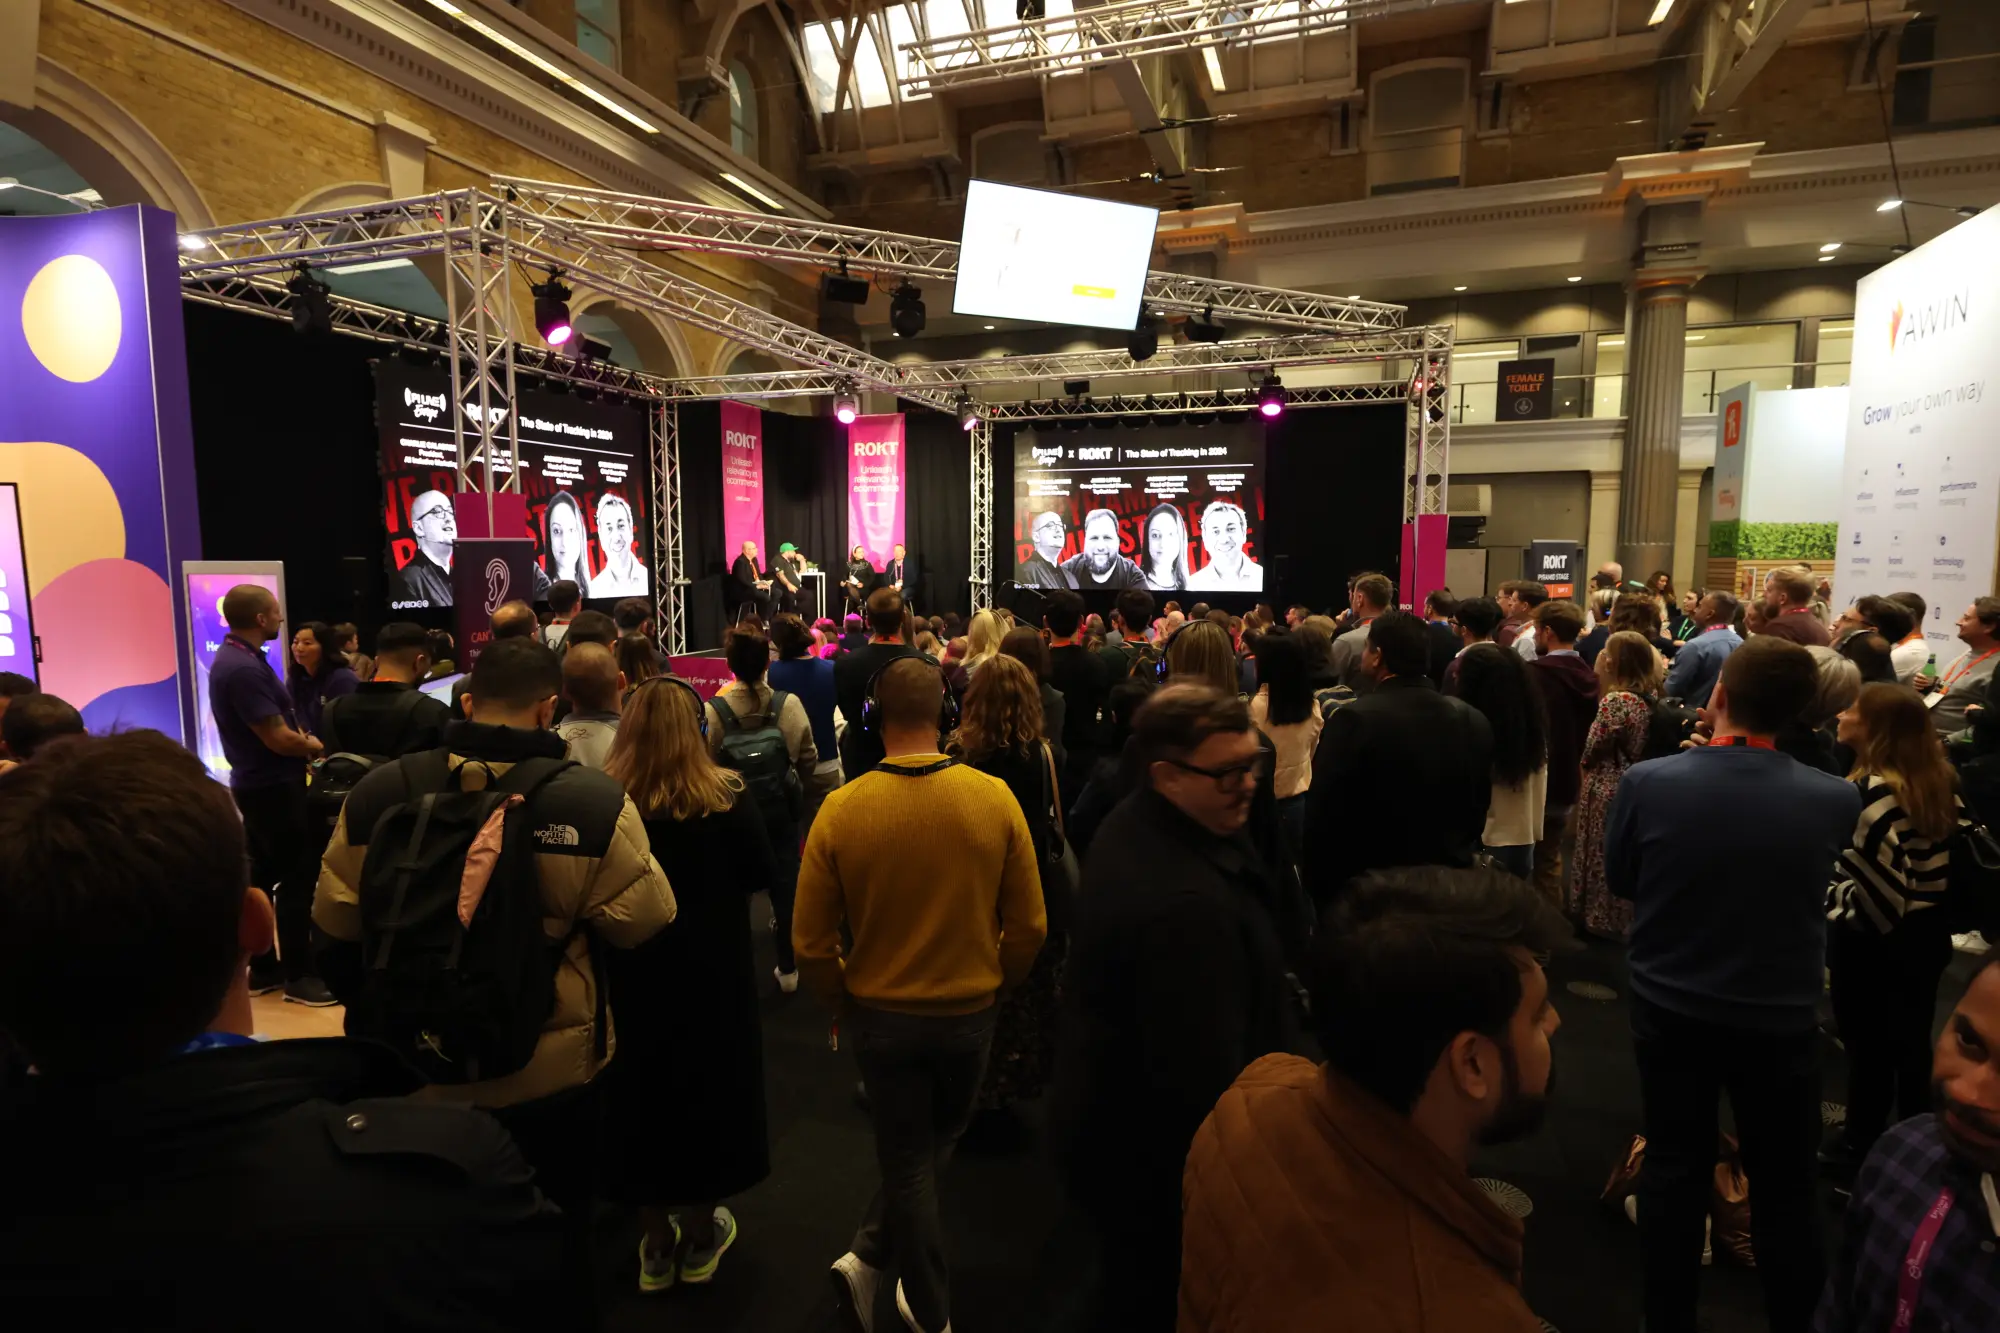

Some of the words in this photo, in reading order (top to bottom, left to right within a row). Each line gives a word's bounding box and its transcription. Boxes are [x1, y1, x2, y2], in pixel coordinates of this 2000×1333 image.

[1903, 286, 1969, 345] AWIN
[1506, 373, 1545, 384] FEMALE
[1508, 383, 1542, 393] TOILET
[1864, 405, 1892, 425] Grow
[1894, 398, 1921, 424] your
[1924, 389, 1952, 410] own
[1957, 379, 1985, 403] way
[519, 416, 534, 429] The
[726, 430, 757, 449] ROKT
[854, 441, 899, 457] ROKT
[1079, 447, 1113, 460] ROKT
[1125, 450, 1140, 458] The
[1160, 449, 1168, 457] of
[1168, 448, 1199, 458] Tracking
[1208, 447, 1227, 456] 2024
[1543, 555, 1567, 569] ROKT
[533, 830, 565, 838] NORTH
[548, 823, 566, 832] THE
